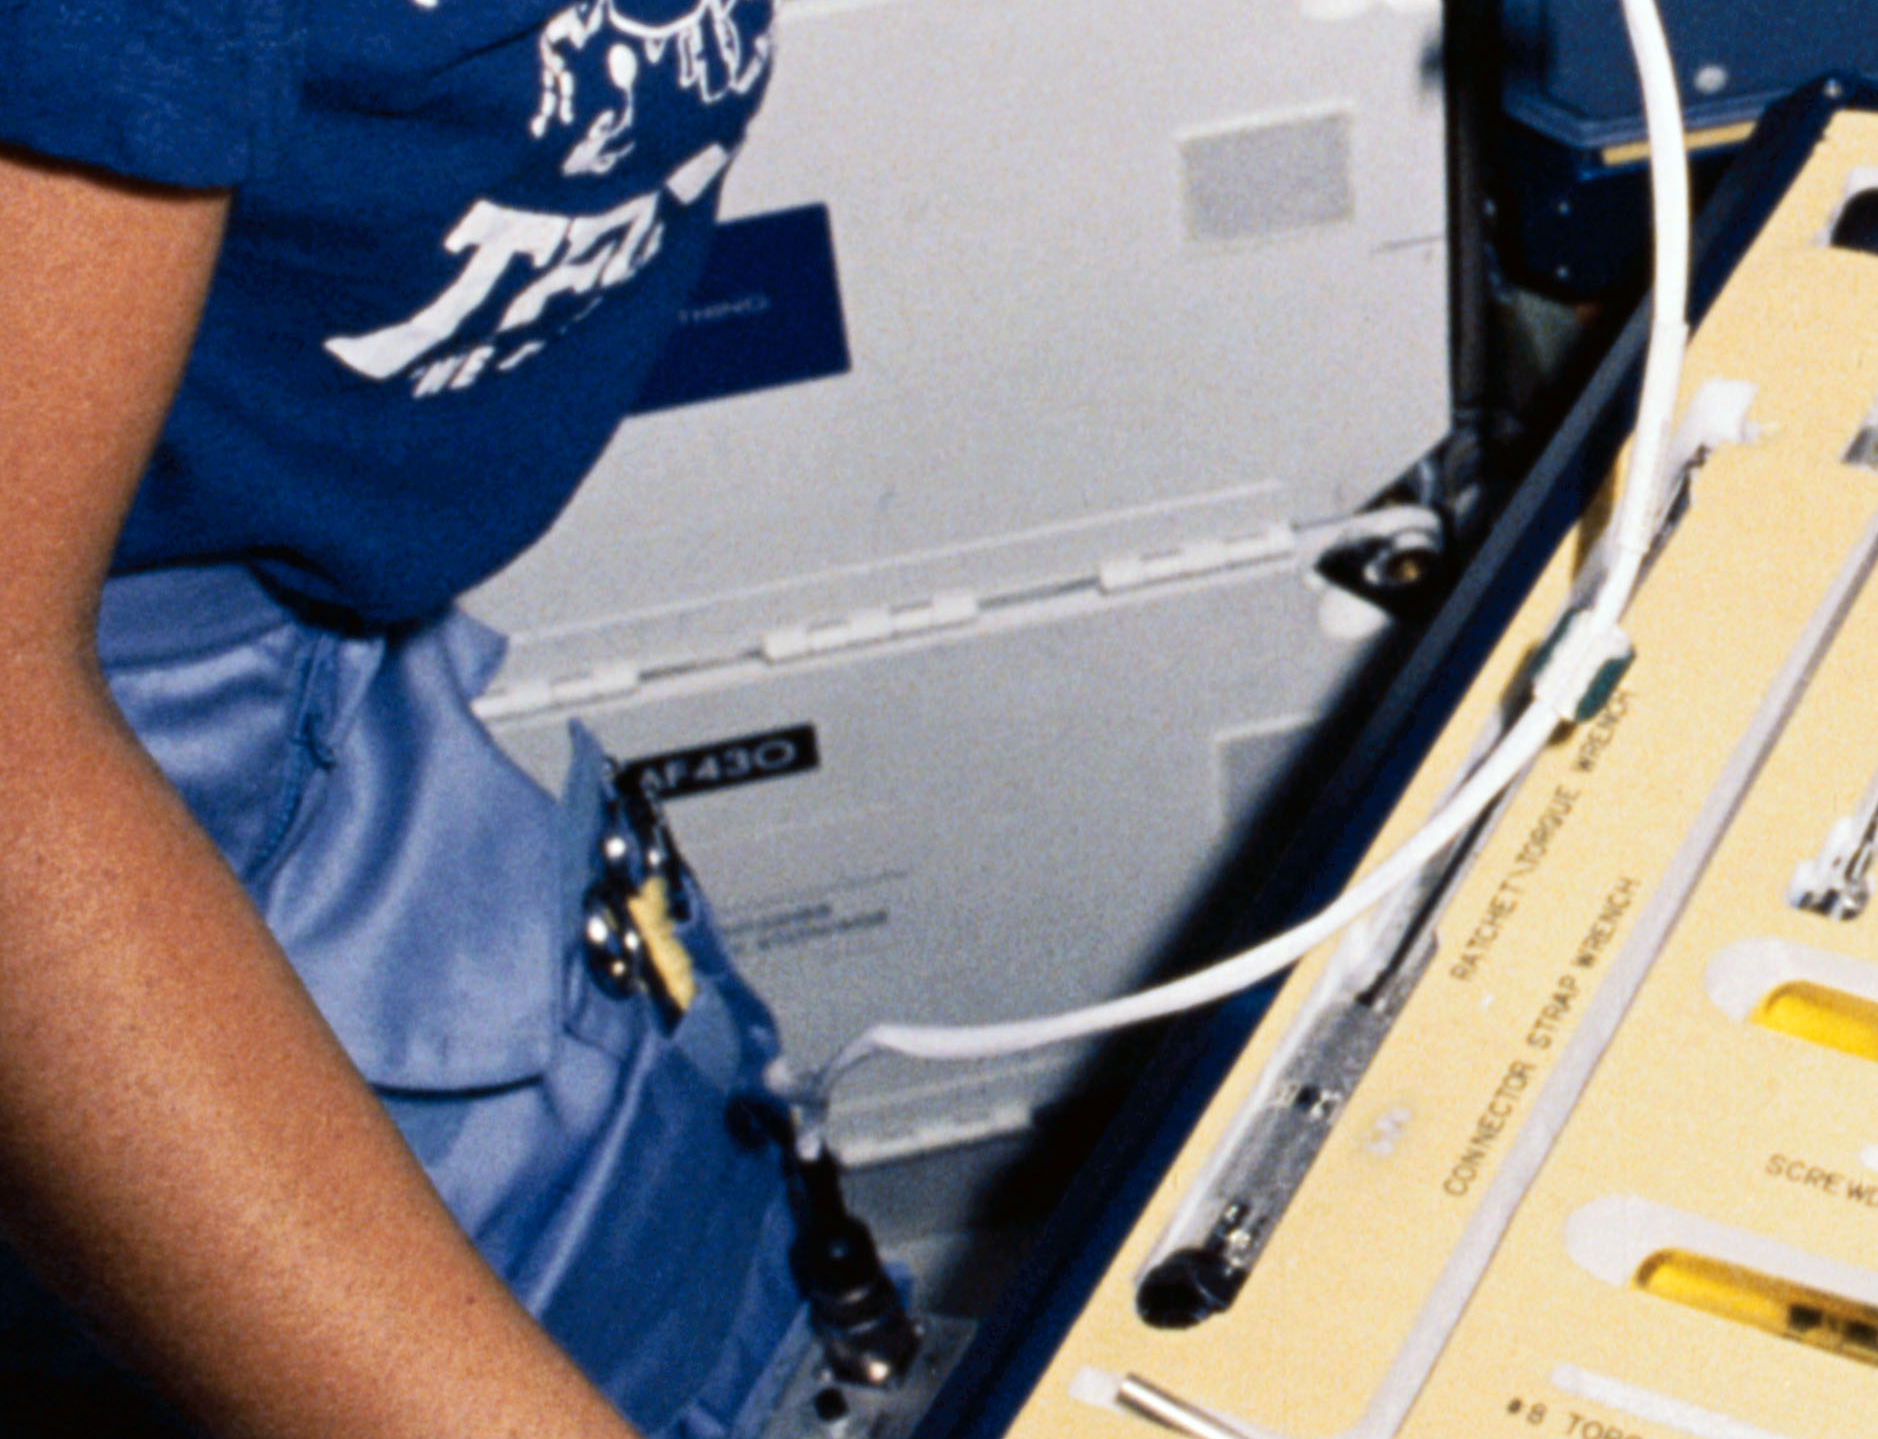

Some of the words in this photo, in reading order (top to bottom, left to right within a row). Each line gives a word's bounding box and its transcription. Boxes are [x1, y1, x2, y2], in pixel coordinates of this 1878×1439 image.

[1573, 685, 1637, 775] WRENCH
[1442, 1058, 1537, 1199] CONNECTOR
[1526, 972, 1581, 1051] STRAP
[1574, 874, 1641, 970] WRENCH
